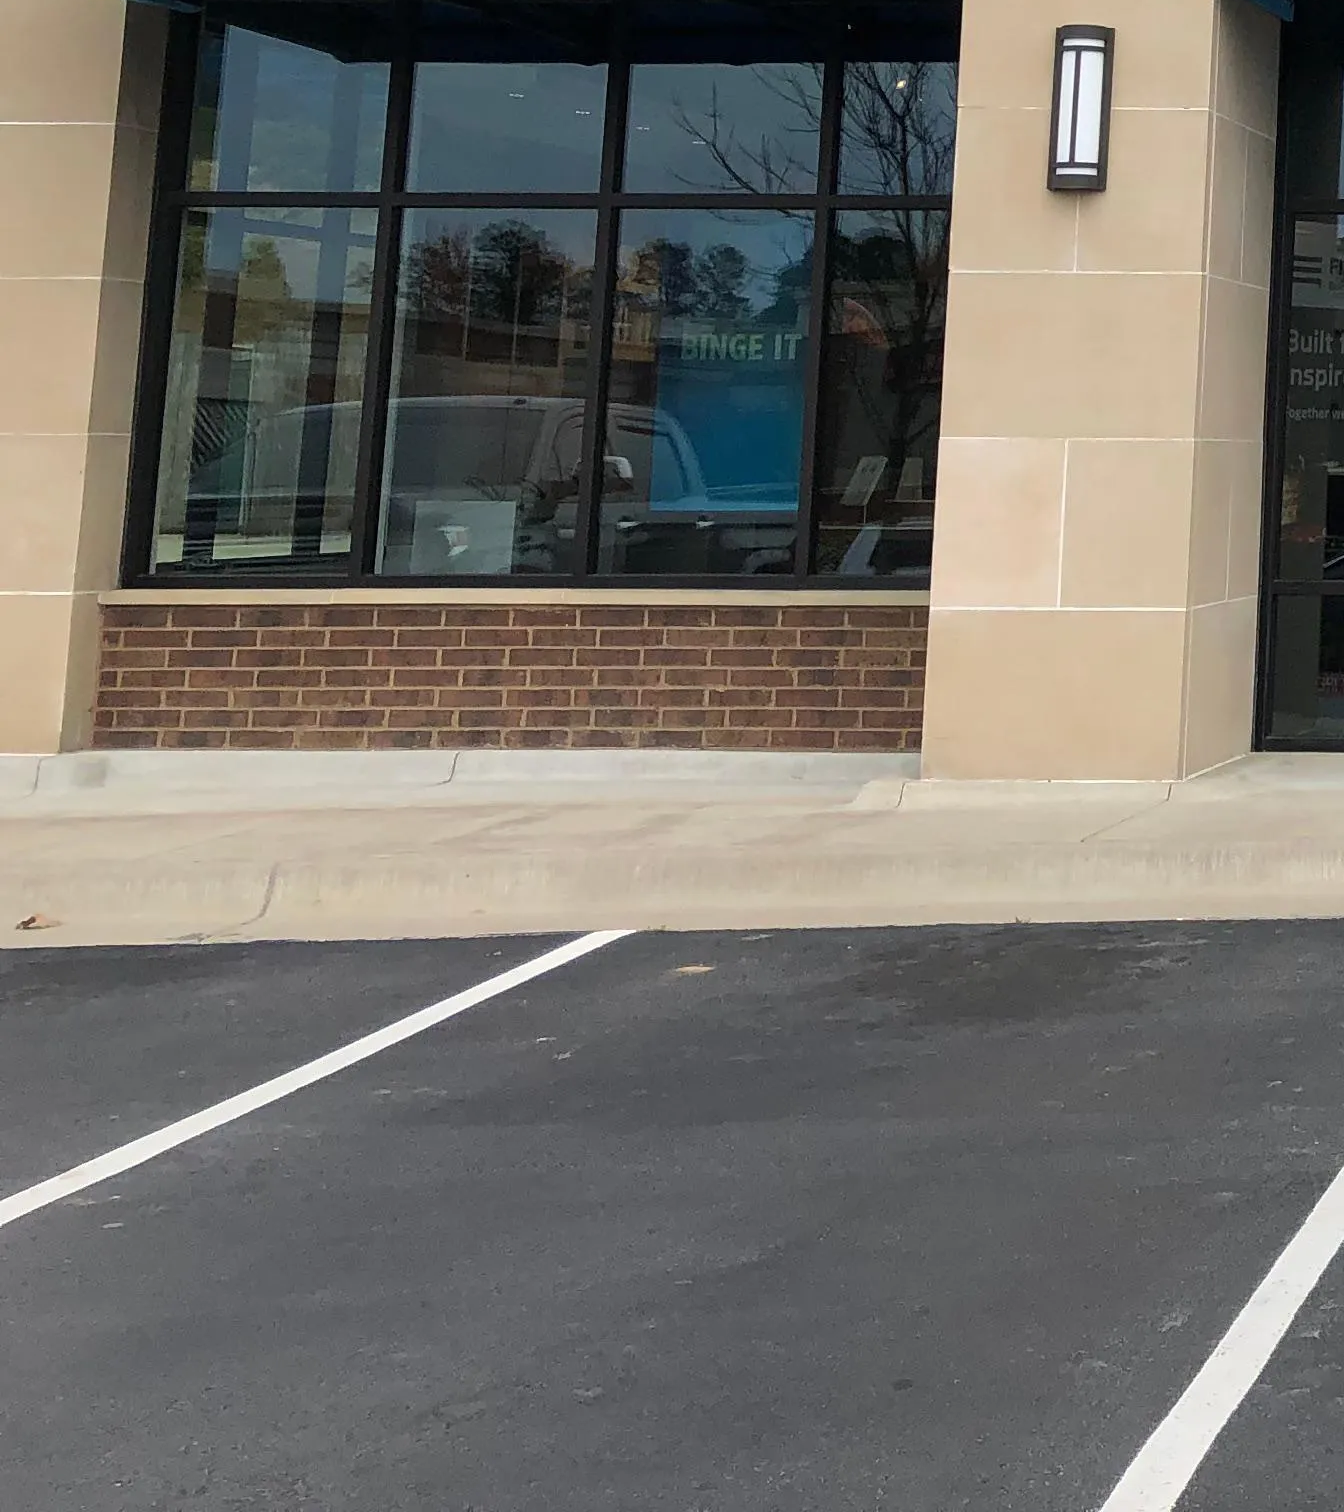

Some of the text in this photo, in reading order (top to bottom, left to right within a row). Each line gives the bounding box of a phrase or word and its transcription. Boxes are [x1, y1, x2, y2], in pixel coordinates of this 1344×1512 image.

[681, 333, 803, 360] BINGE IT
[1288, 328, 1334, 355] Built
